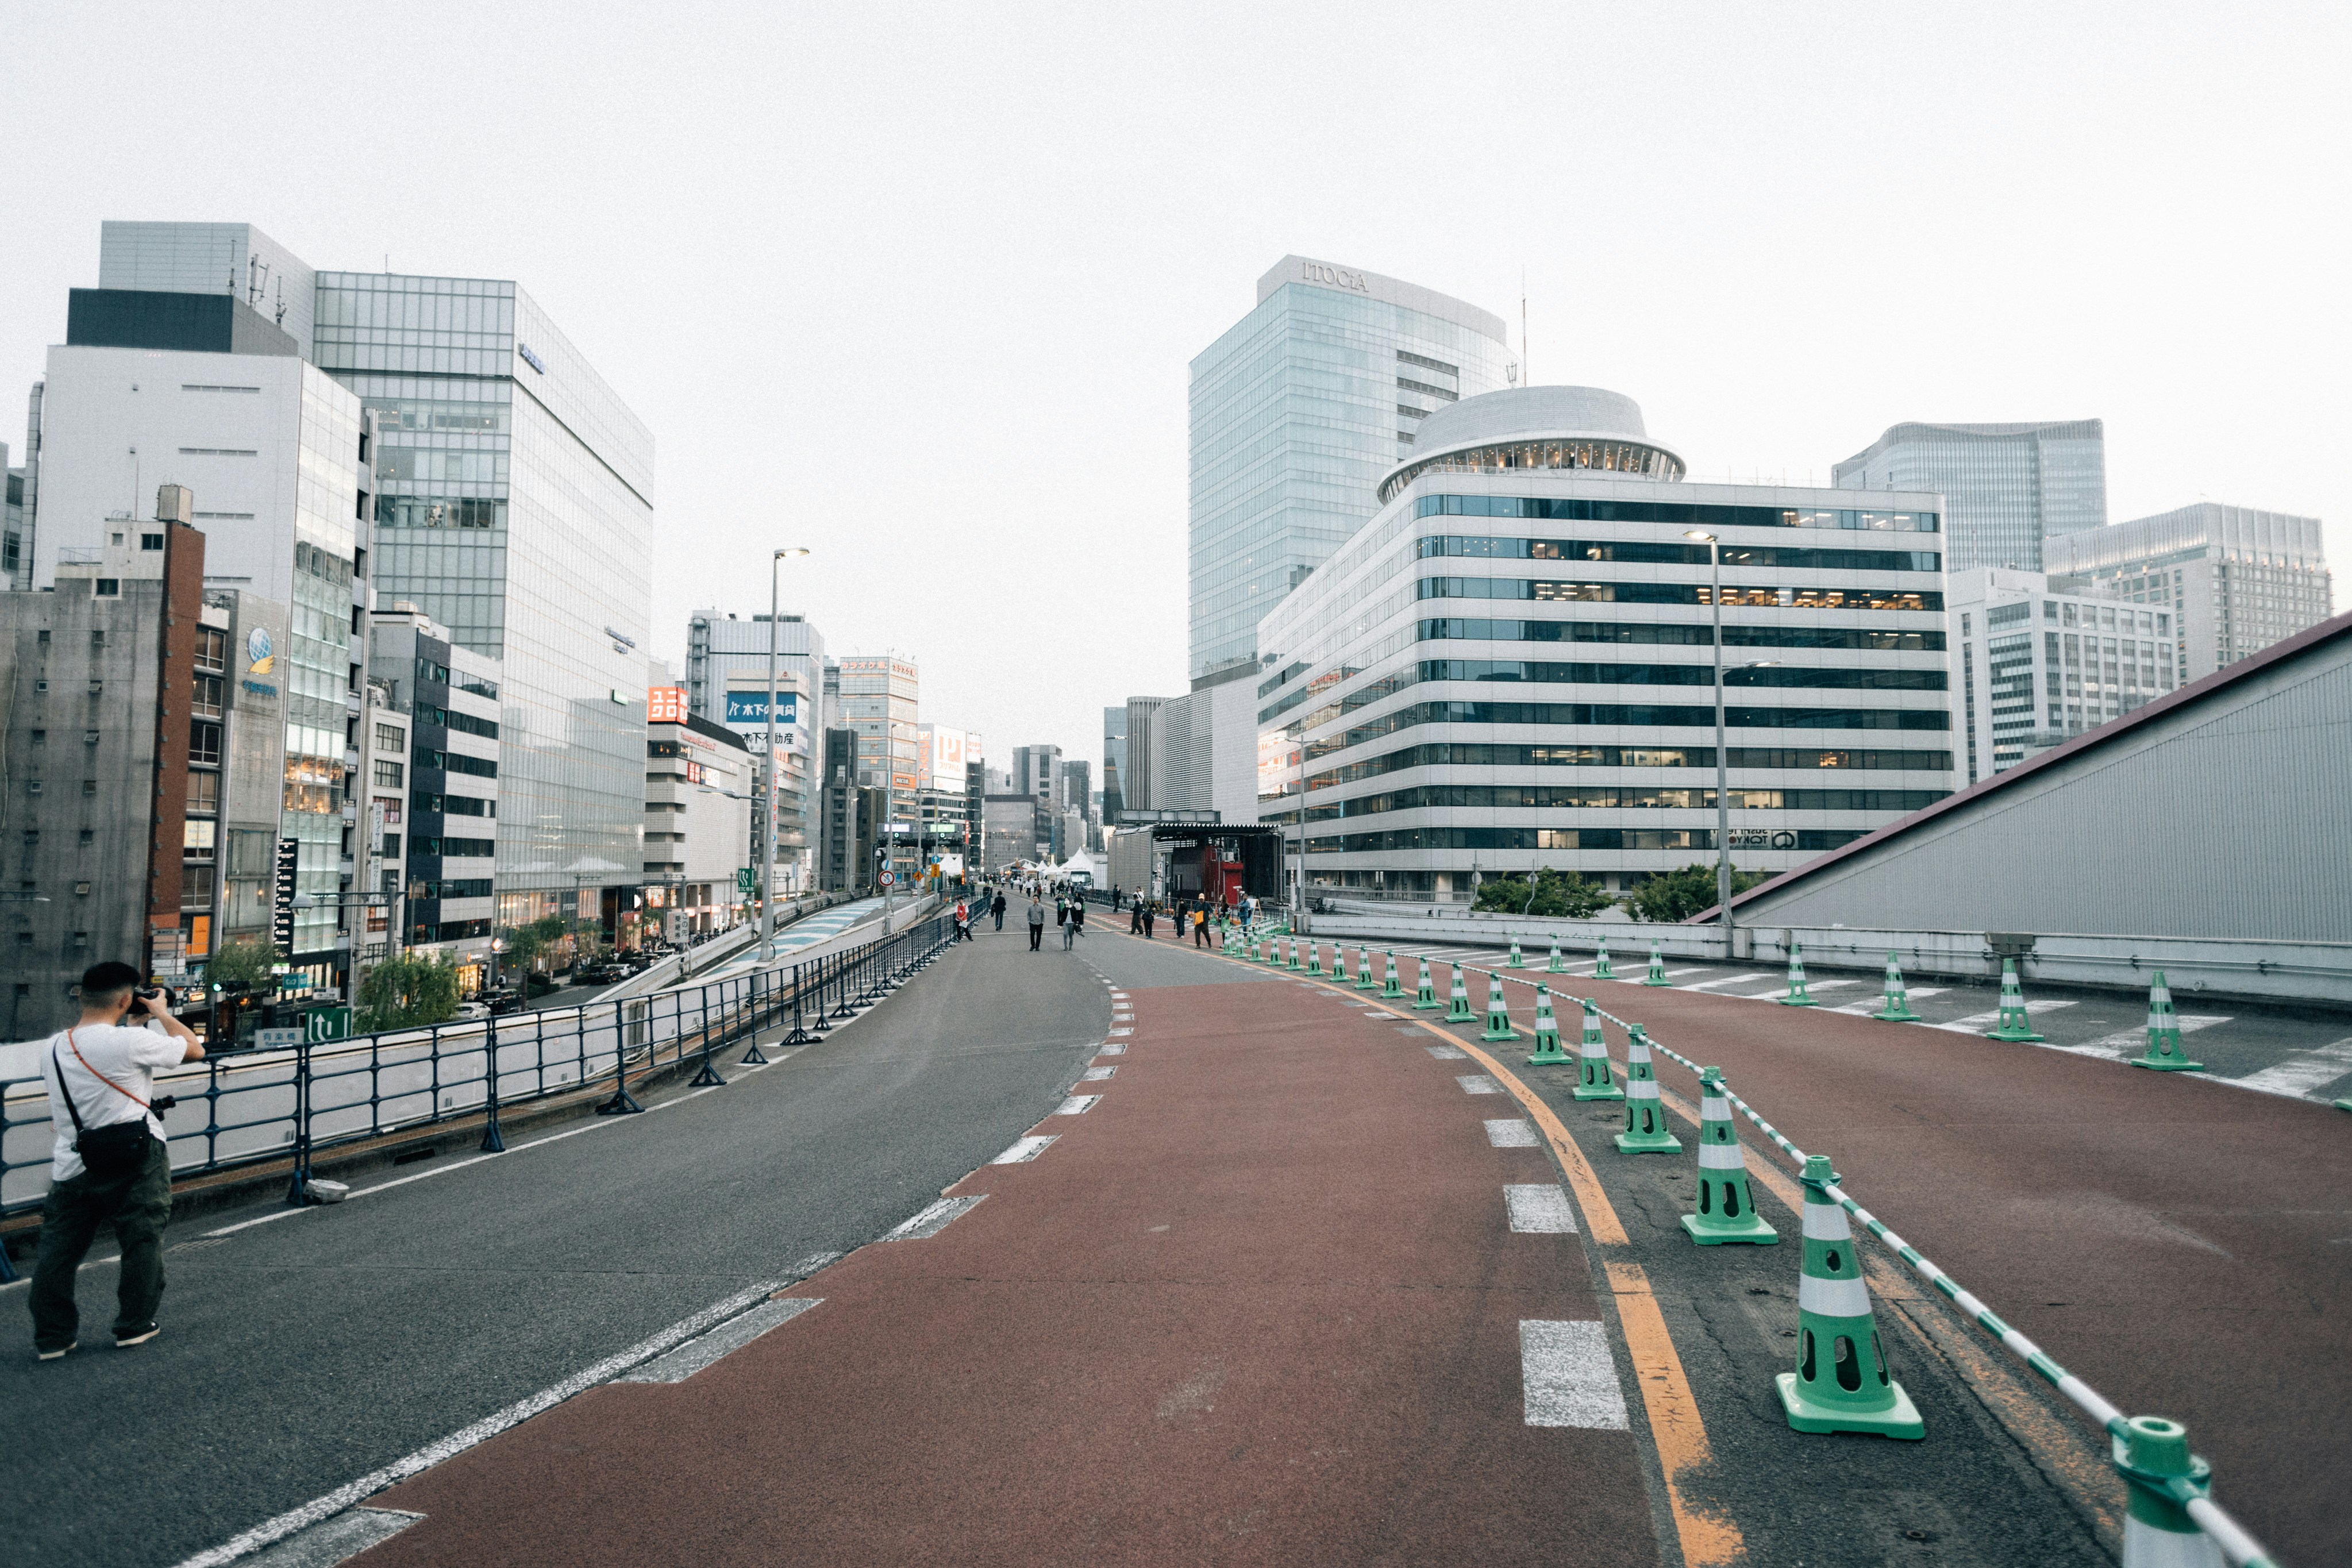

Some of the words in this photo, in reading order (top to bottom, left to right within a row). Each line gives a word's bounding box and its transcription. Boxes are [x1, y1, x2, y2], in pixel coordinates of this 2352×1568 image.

[653, 691, 678, 703] ユニ
[651, 705, 677, 718] クロ
[263, 1033, 295, 1041] 有楽橋
